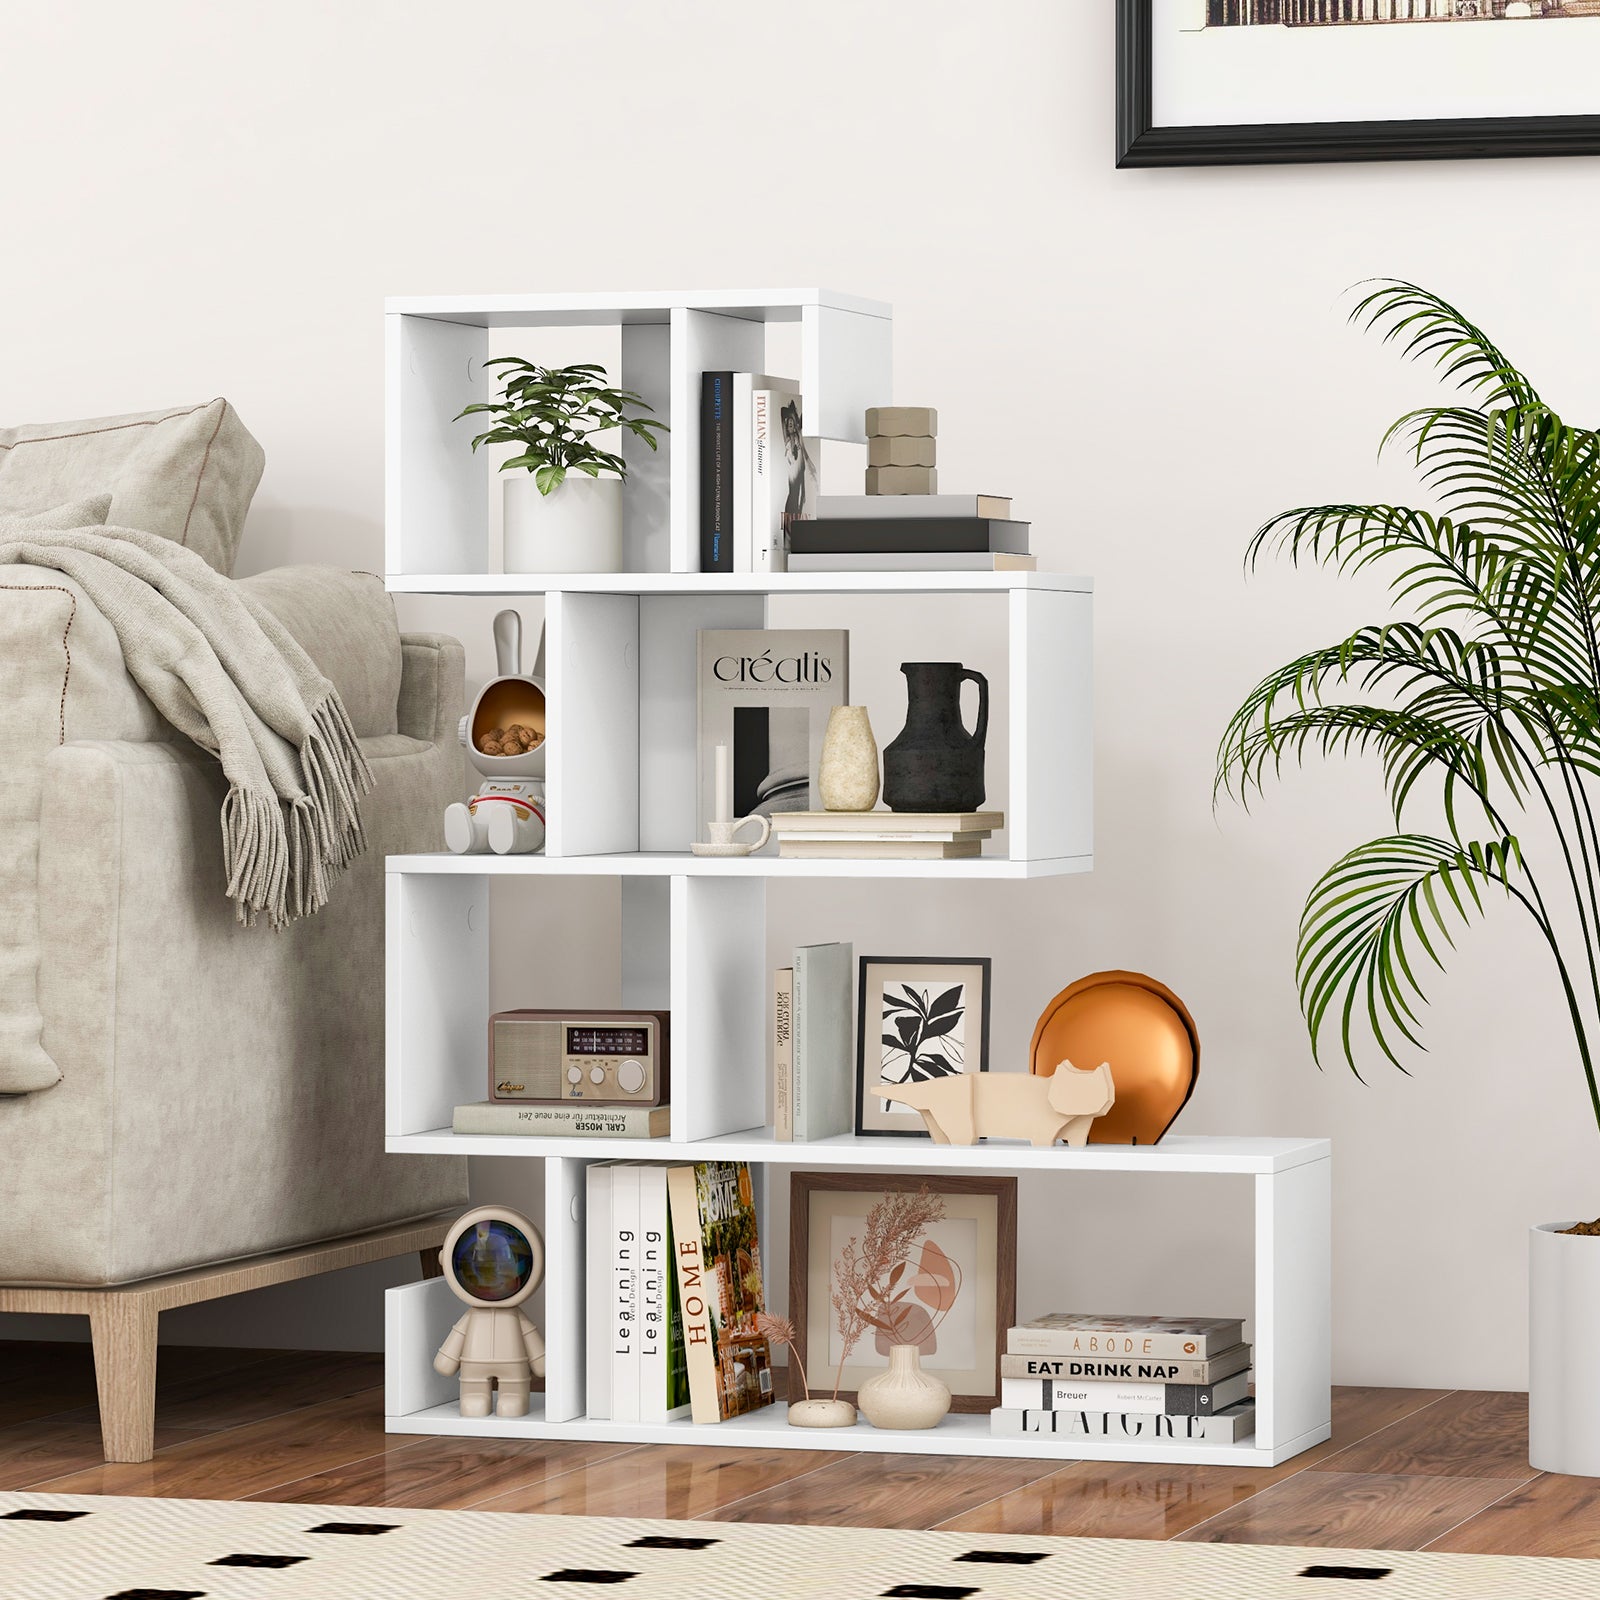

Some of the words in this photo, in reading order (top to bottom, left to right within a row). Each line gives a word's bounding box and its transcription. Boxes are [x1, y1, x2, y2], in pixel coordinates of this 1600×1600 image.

[757, 396, 766, 439] ITALIAN
[713, 648, 832, 683] créatis
[518, 1112, 533, 1121] Zeit
[534, 1112, 553, 1120] neue
[554, 1113, 571, 1121] eine
[571, 1113, 584, 1122] für
[585, 1113, 627, 1123] Architektur
[575, 1122, 603, 1131] MOSER
[605, 1123, 626, 1132] CARL
[698, 1180, 740, 1225] HOME
[616, 1230, 634, 1354] Learning
[629, 1269, 637, 1299] Design
[642, 1231, 661, 1355] Learning
[656, 1270, 664, 1300] Design
[679, 1240, 708, 1346] HOME
[1027, 1361, 1063, 1375] EAT
[1070, 1363, 1132, 1377] DRINK
[1138, 1365, 1179, 1379] NAP
[1056, 1390, 1088, 1401] Breuer
